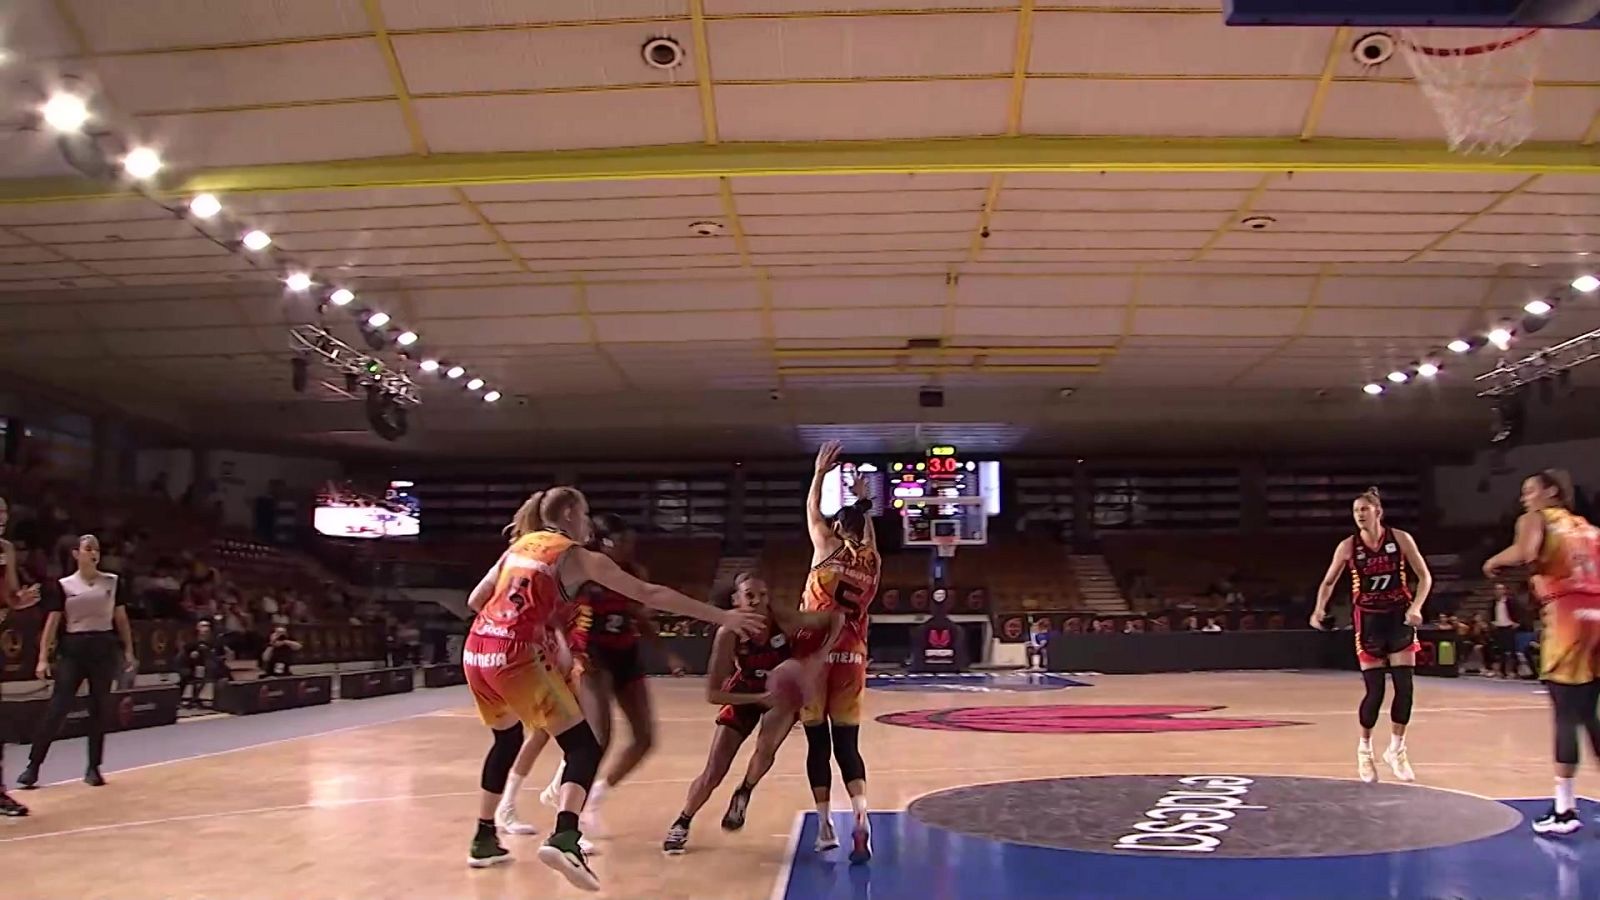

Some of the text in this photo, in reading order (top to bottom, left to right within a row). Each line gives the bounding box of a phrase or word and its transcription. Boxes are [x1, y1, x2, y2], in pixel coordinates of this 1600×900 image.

[929, 458, 956, 472] 3.0
[1370, 574, 1392, 590] 77
[834, 580, 864, 617] 5
[1112, 776, 1269, 852] endesa
